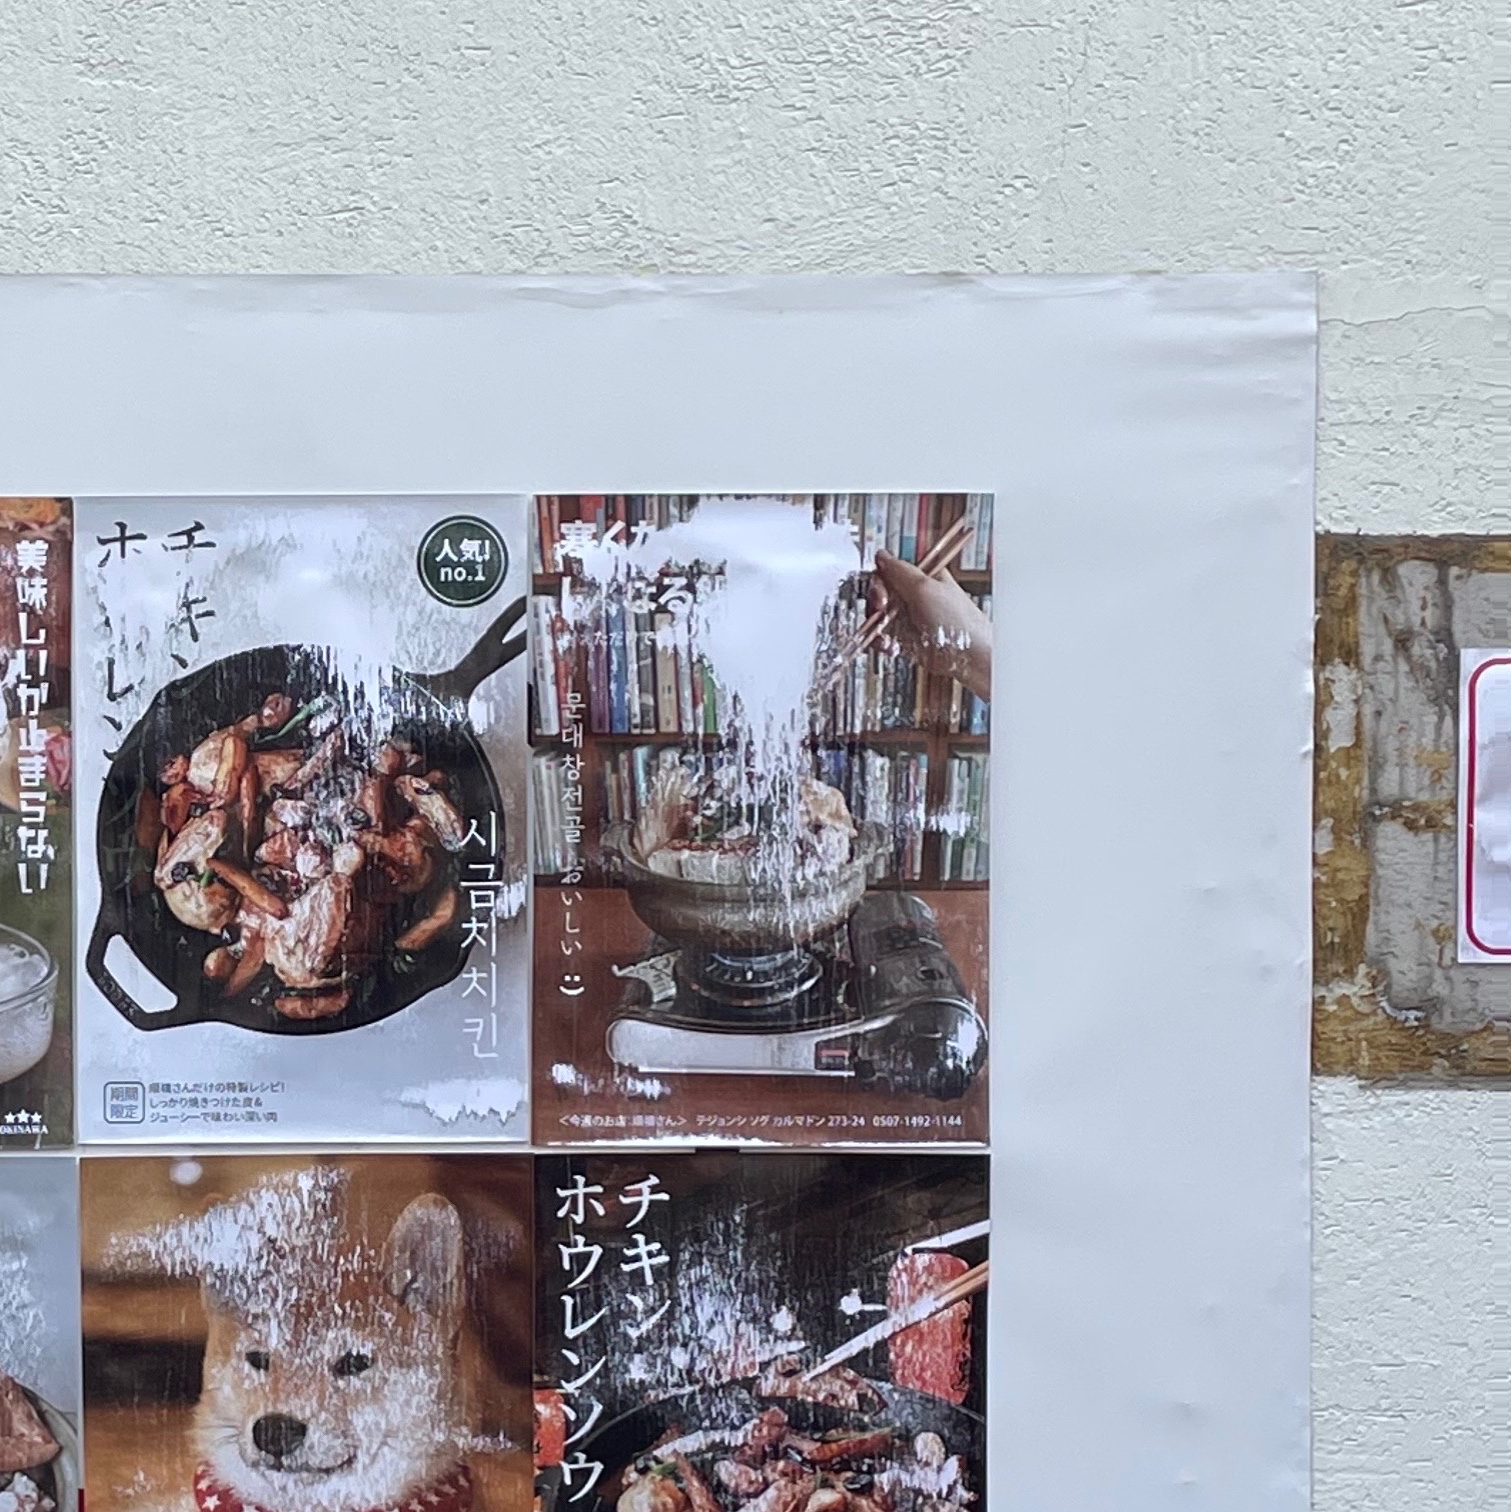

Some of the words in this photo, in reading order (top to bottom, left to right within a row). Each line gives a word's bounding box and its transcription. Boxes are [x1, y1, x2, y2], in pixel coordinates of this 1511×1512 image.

[434, 537, 491, 562] 人気!
[439, 564, 487, 582] no.1
[16, 538, 55, 895] 美味しいが止まらない
[556, 1173, 607, 1503] ホウレンソウ
[618, 1173, 671, 1339] チキン
